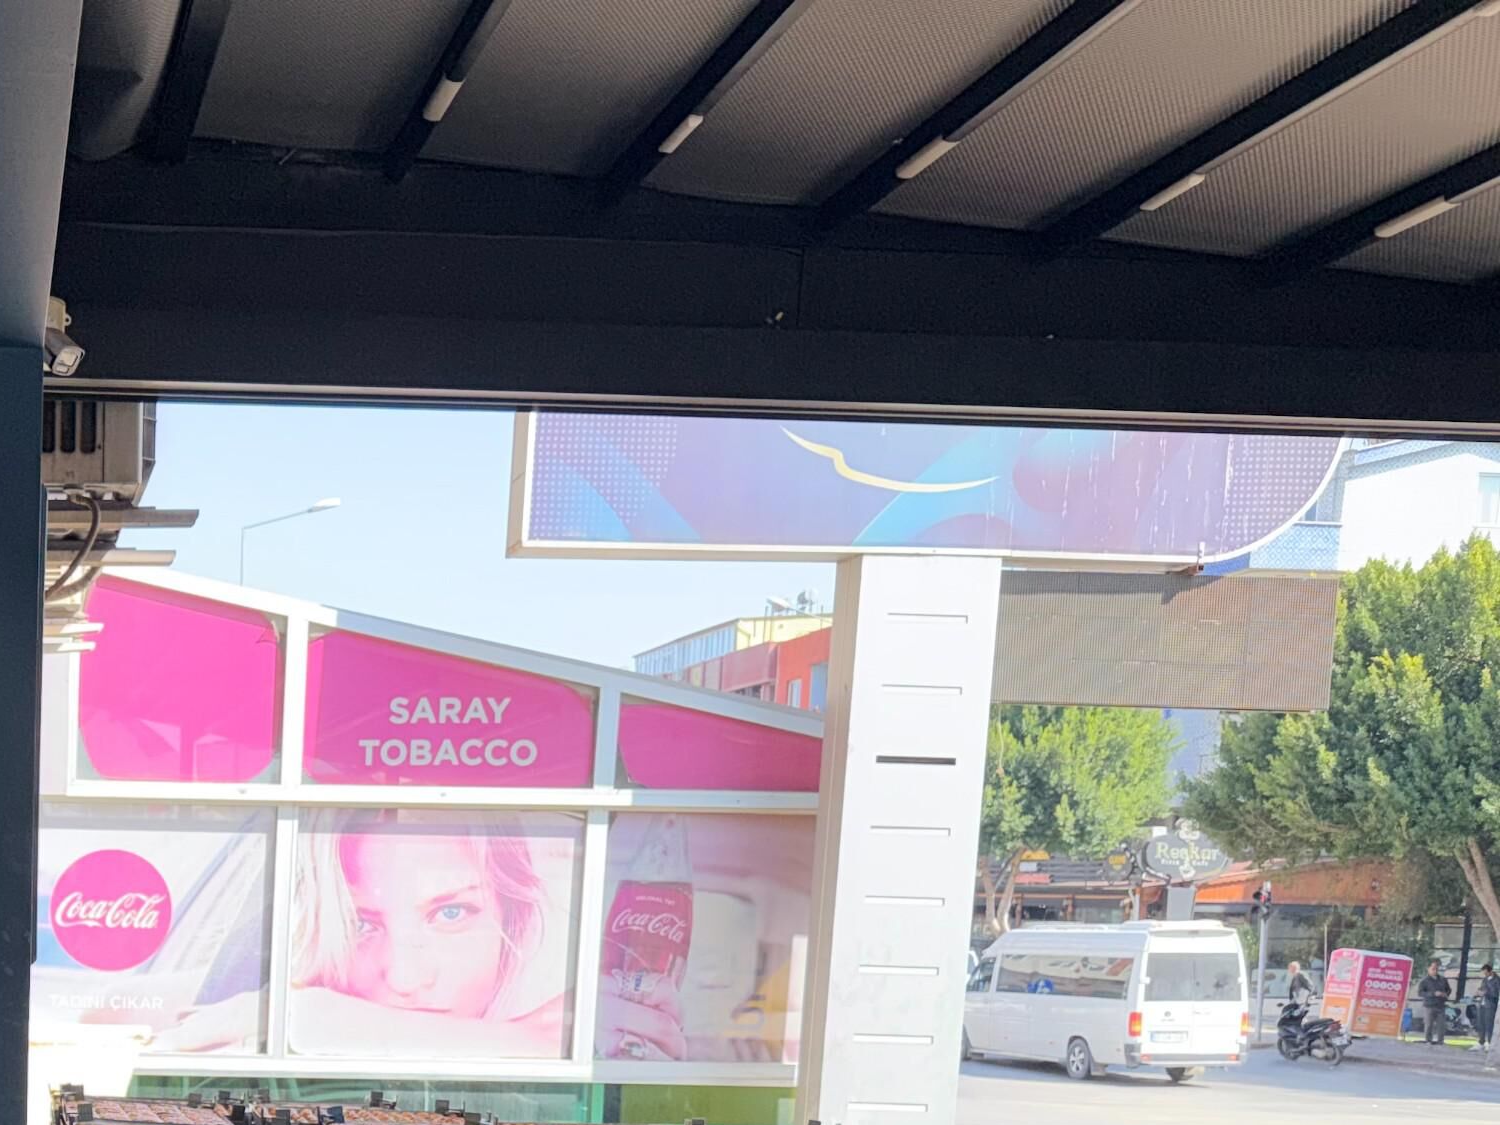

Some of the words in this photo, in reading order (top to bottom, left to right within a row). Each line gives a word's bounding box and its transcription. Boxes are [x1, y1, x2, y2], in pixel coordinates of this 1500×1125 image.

[389, 696, 512, 725] SARAY
[358, 738, 538, 767] TOBACCO
[55, 891, 167, 929] Coca-Cola
[611, 908, 687, 944] Coca-Cola
[109, 994, 165, 1012] ÇIKAR
